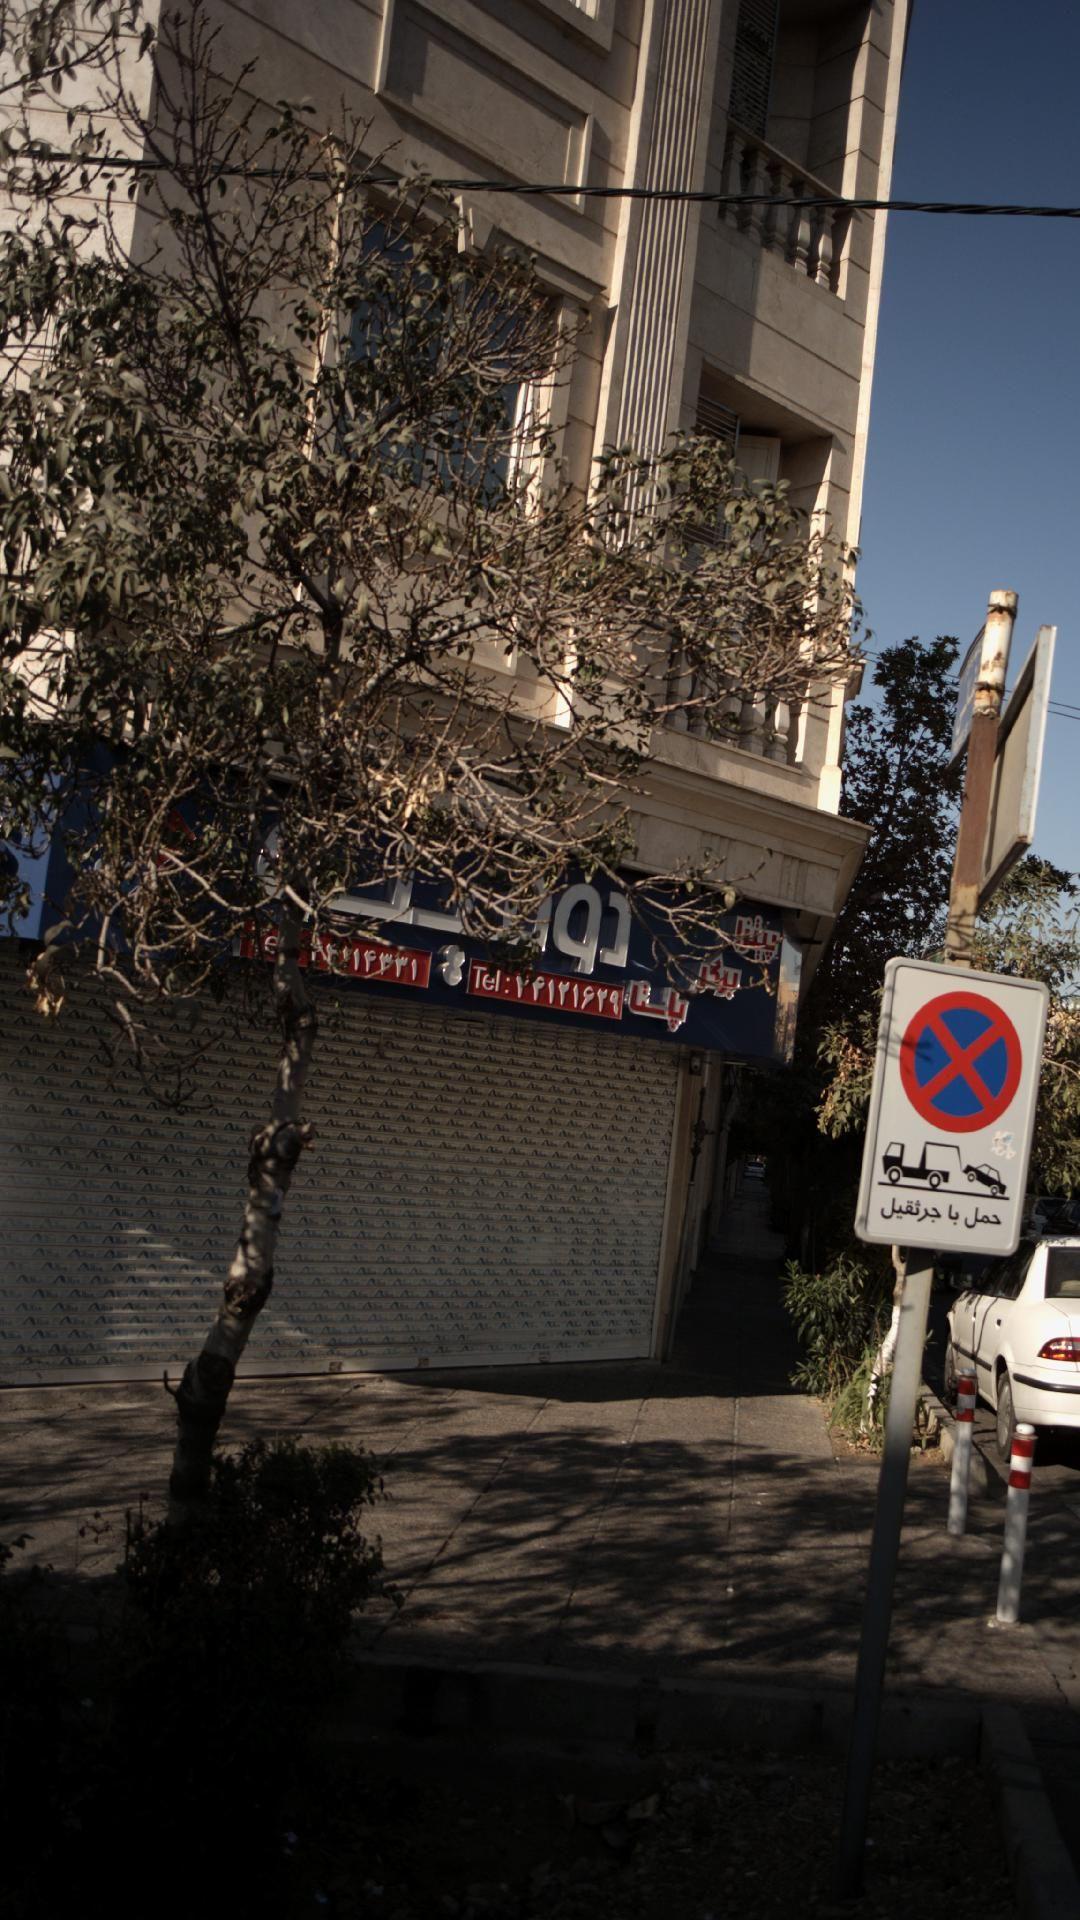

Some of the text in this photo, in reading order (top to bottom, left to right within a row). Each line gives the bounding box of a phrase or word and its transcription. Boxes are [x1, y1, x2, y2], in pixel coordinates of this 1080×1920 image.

[881, 1198, 1001, 1229] حمل با جرثقیل
